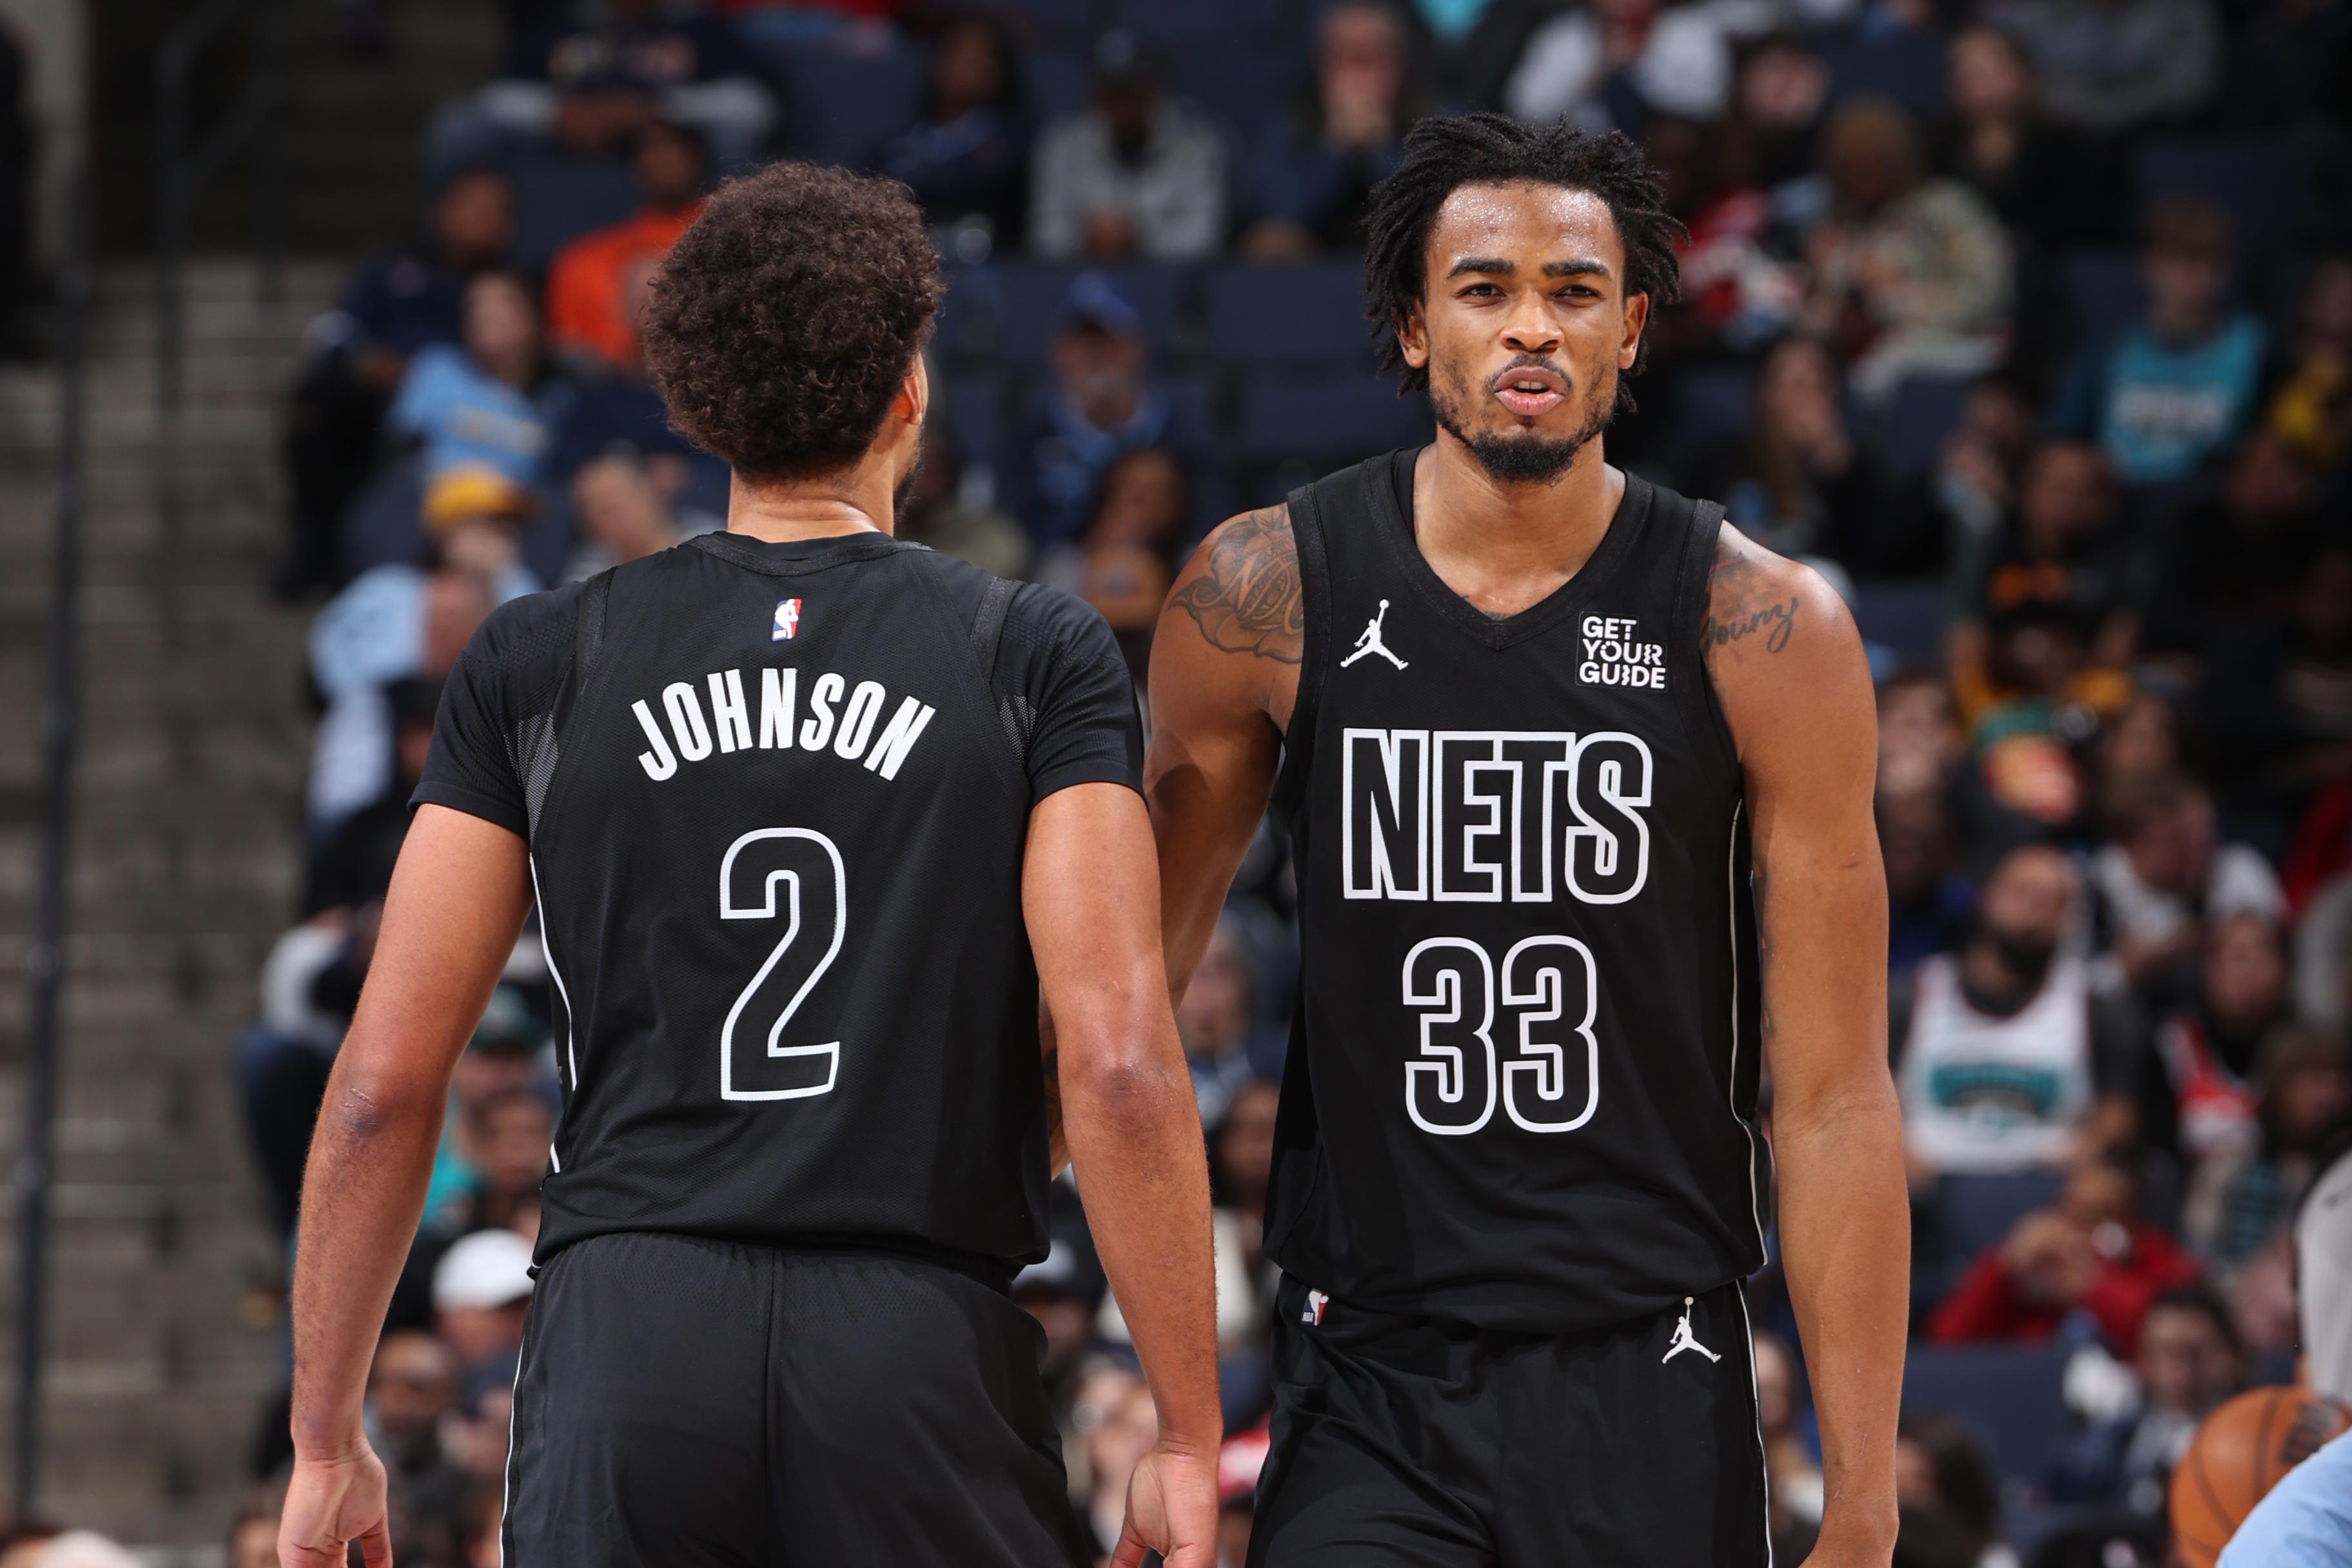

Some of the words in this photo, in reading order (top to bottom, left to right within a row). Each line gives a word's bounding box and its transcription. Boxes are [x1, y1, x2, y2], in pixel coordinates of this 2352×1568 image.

[1579, 662, 1666, 689] GUIDE
[1582, 616, 1637, 640] GET
[1582, 638, 1663, 665] YOUR
[631, 668, 936, 781] JOHNSON
[1343, 728, 1652, 904] NETS
[720, 827, 846, 1101] 2
[1402, 935, 1599, 1135] 33
